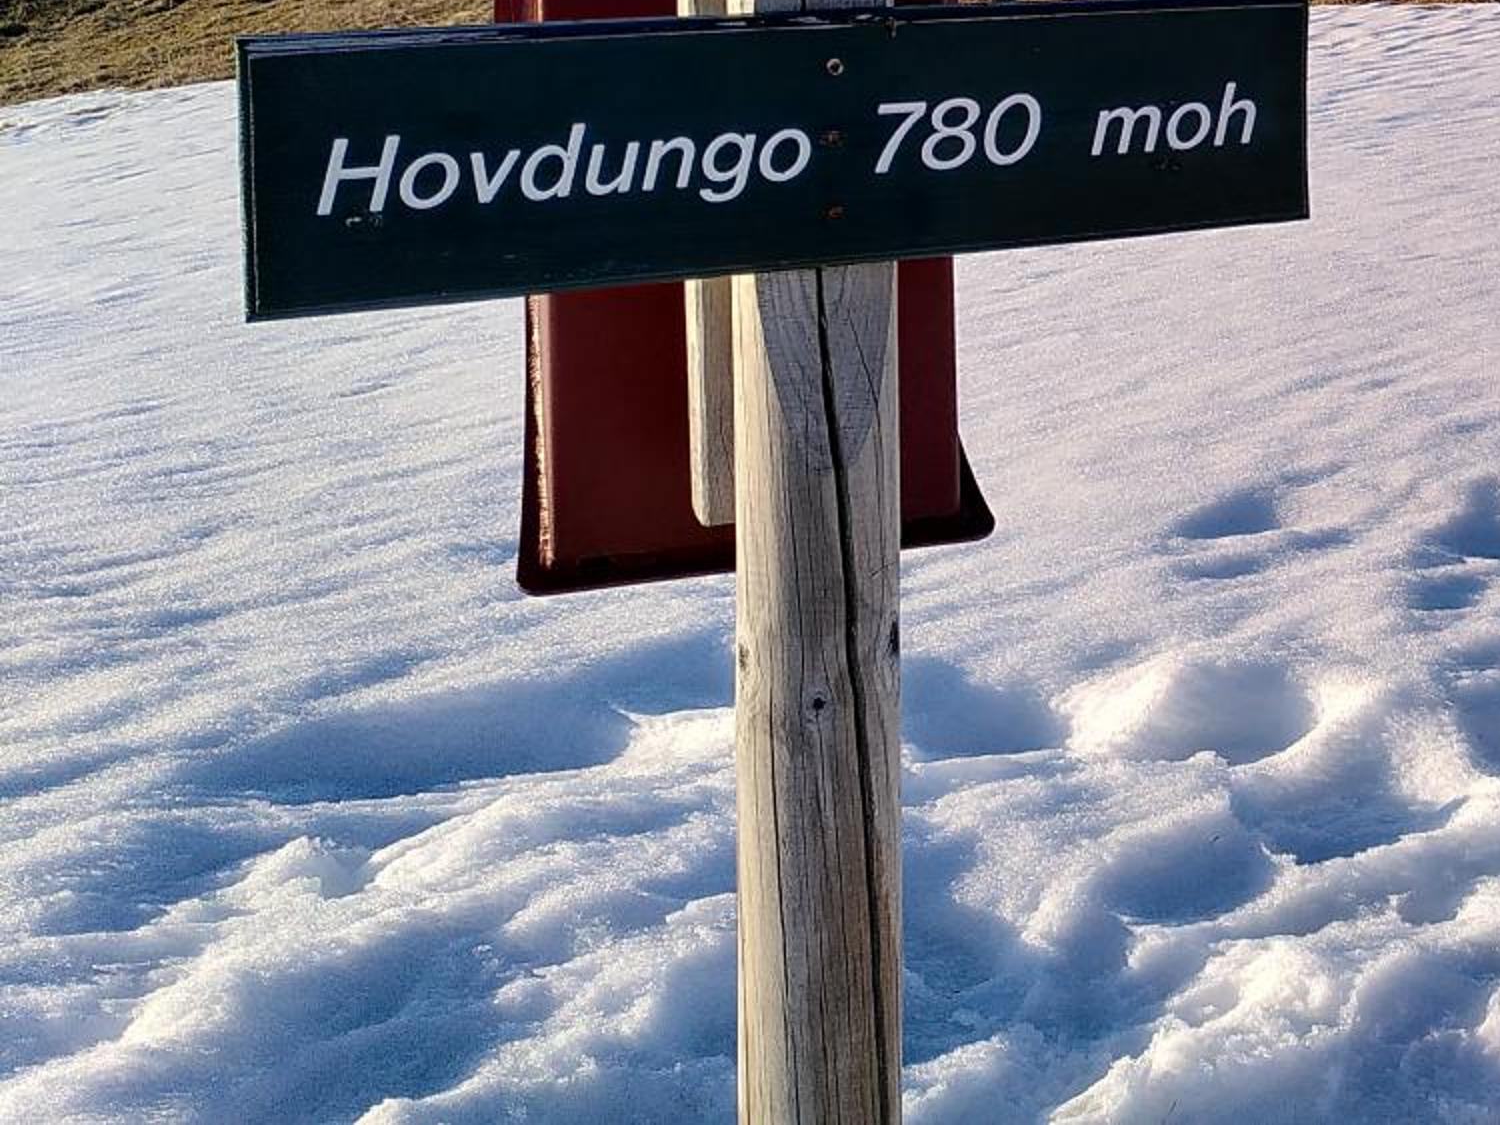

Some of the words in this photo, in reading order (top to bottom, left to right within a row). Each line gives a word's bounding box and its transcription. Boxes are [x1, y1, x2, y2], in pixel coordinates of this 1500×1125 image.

[316, 121, 812, 216] Hovdungo
[874, 93, 1042, 174] 780
[1090, 81, 1257, 157] moh
